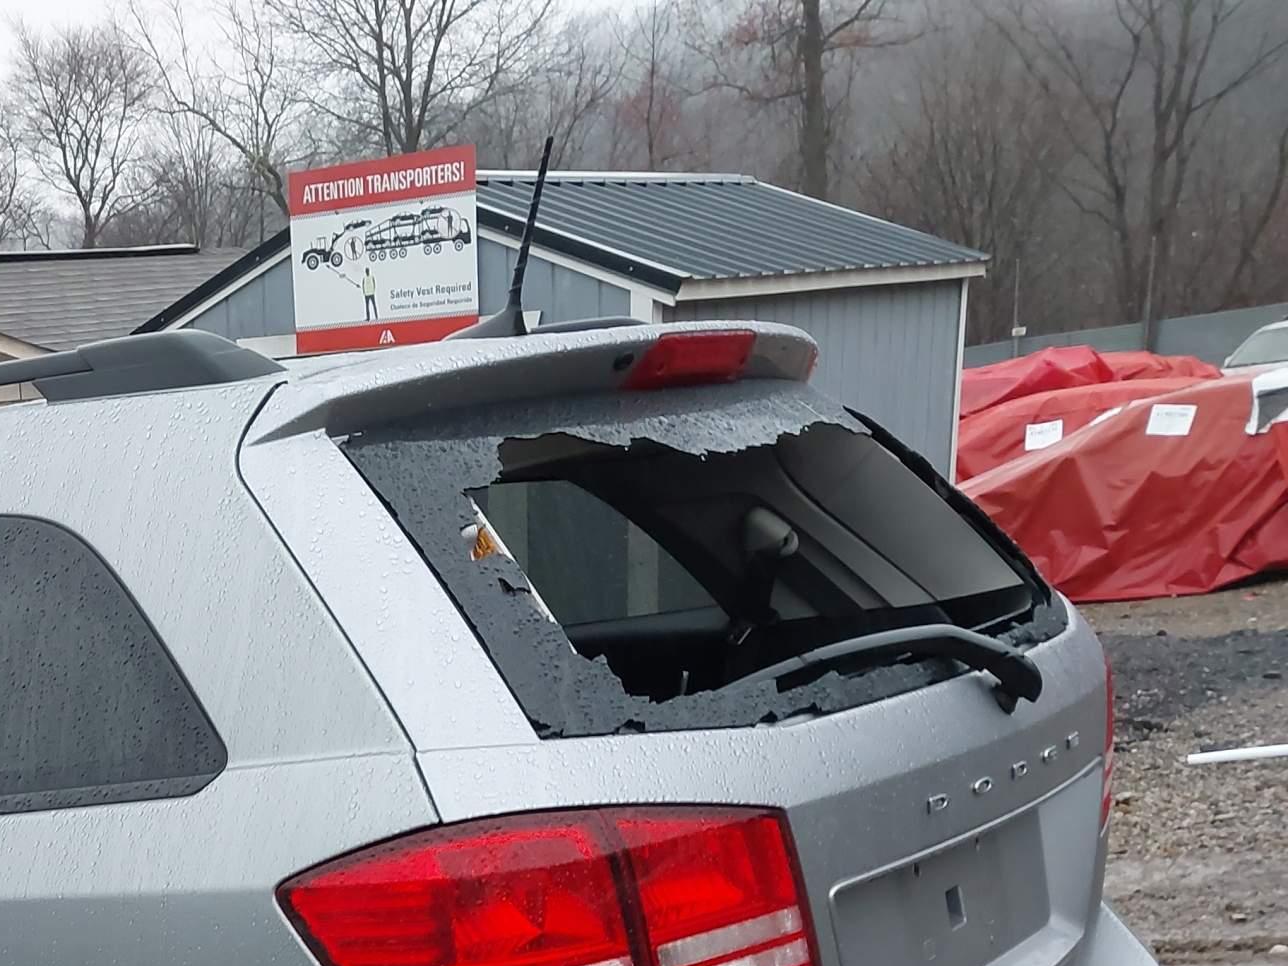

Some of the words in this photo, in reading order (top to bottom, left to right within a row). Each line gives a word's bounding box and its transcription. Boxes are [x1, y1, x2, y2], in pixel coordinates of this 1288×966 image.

[303, 176, 364, 205] ATTENTION
[367, 161, 465, 194] TRANSPORTERS!
[390, 288, 414, 299] Safety
[416, 286, 434, 296] Vest
[435, 281, 472, 296] Required
[927, 731, 1080, 815] DODGE
